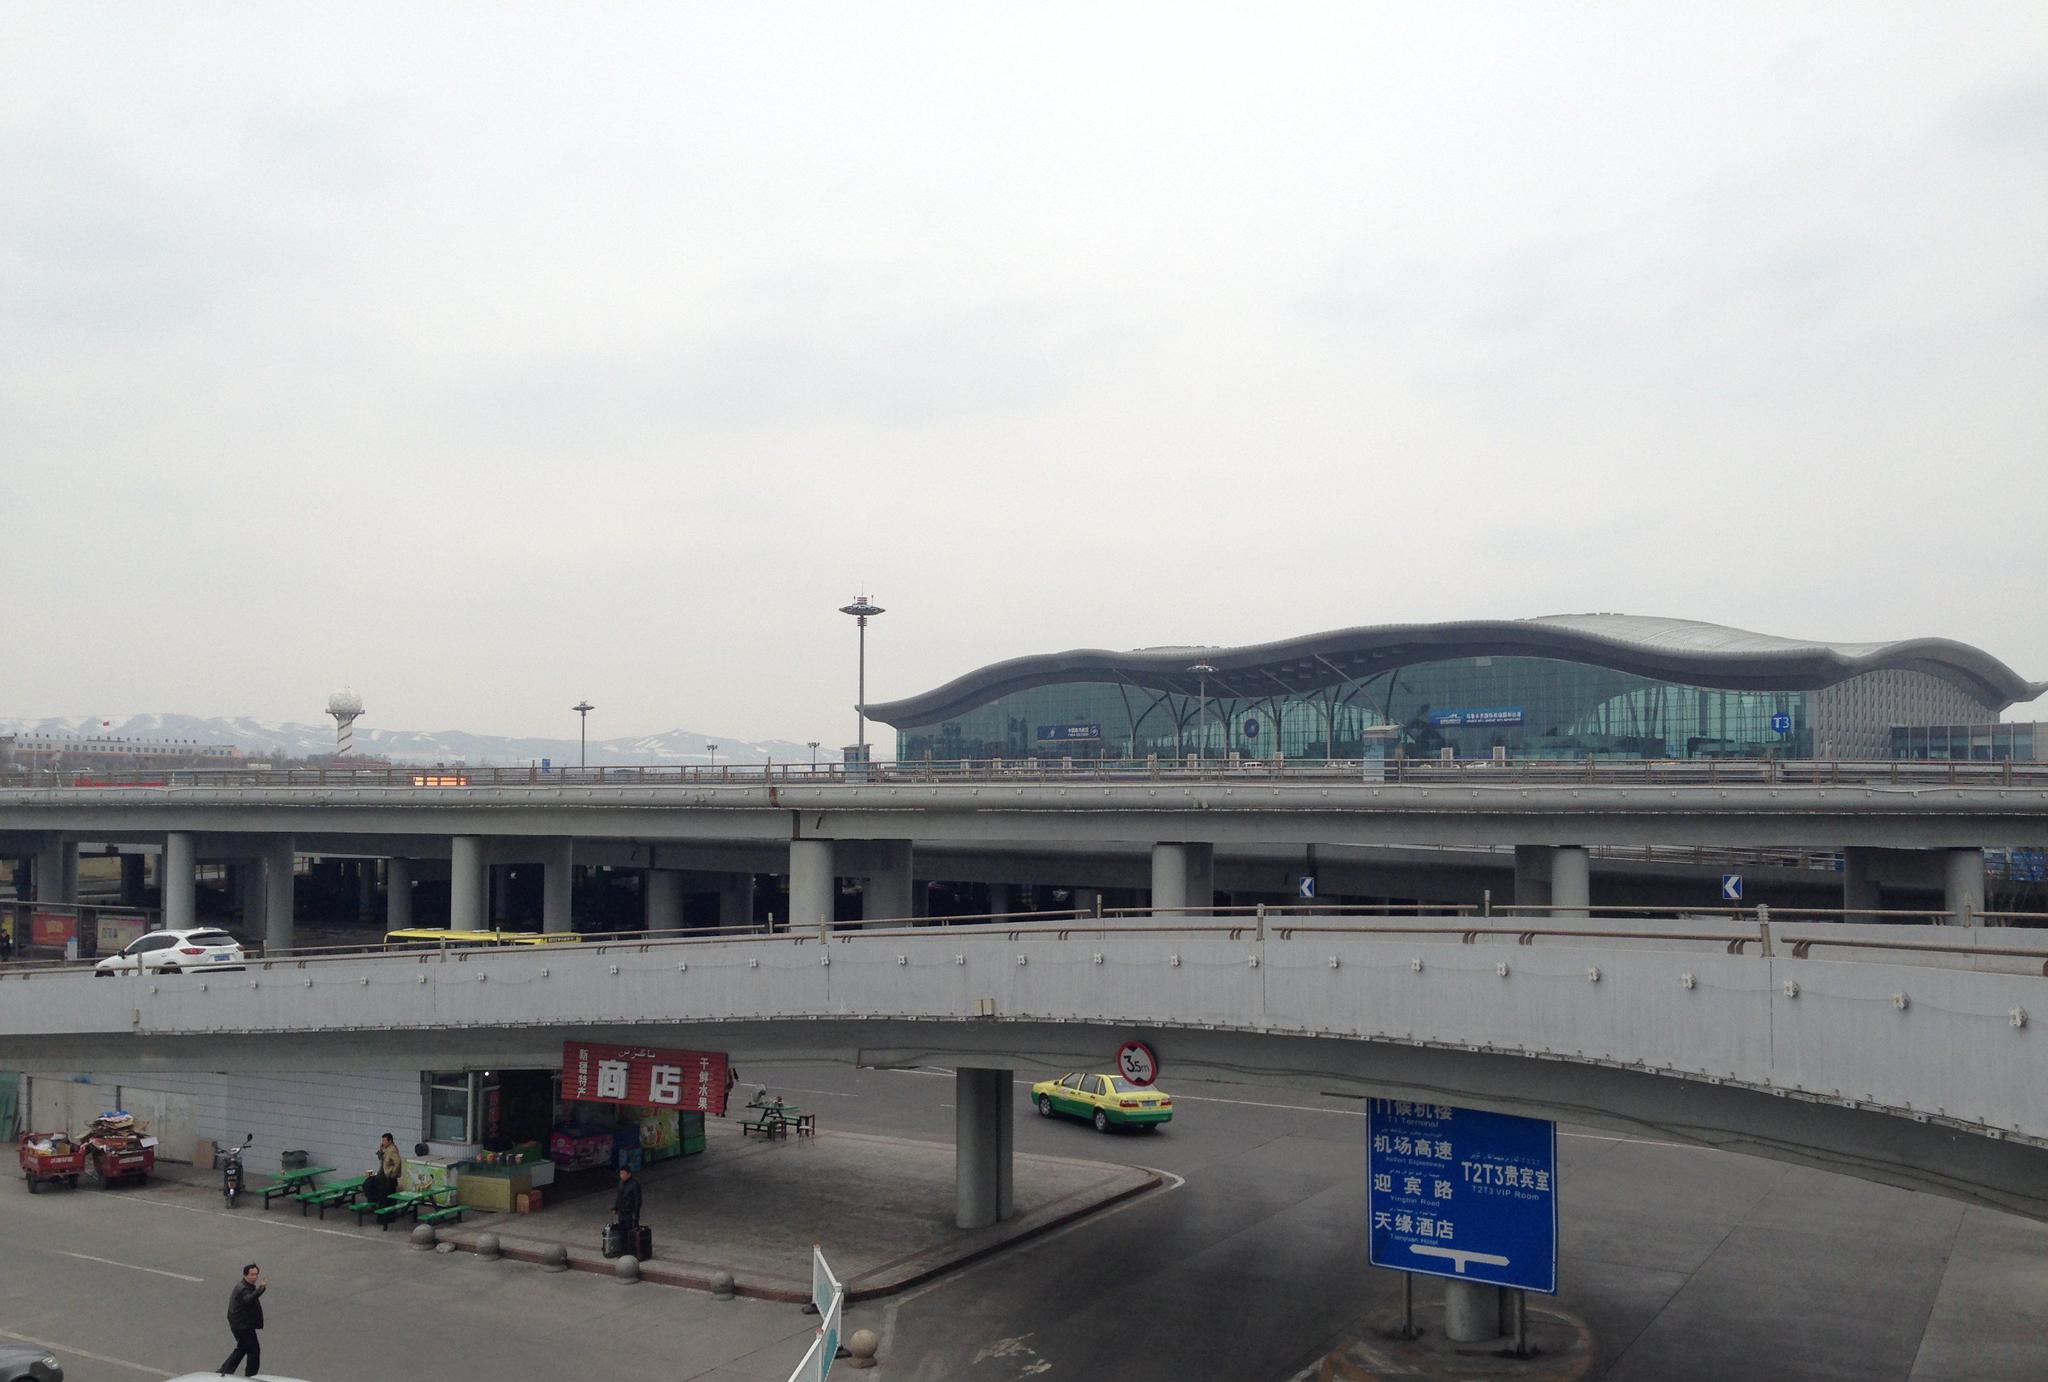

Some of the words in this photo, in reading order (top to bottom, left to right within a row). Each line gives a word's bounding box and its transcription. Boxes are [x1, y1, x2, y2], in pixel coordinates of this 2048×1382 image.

[1773, 717, 1790, 728] T3
[597, 1059, 682, 1105] 商店
[1374, 1134, 1453, 1161] 机场高速
[1374, 1173, 1453, 1200] 迎宾路
[1461, 1161, 1550, 1191] T2T3贵宾室
[1472, 1184, 1495, 1195] T2T3
[1496, 1188, 1512, 1197] VIP
[1514, 1190, 1540, 1201] Room
[1375, 1211, 1454, 1240] 天缘酒店
